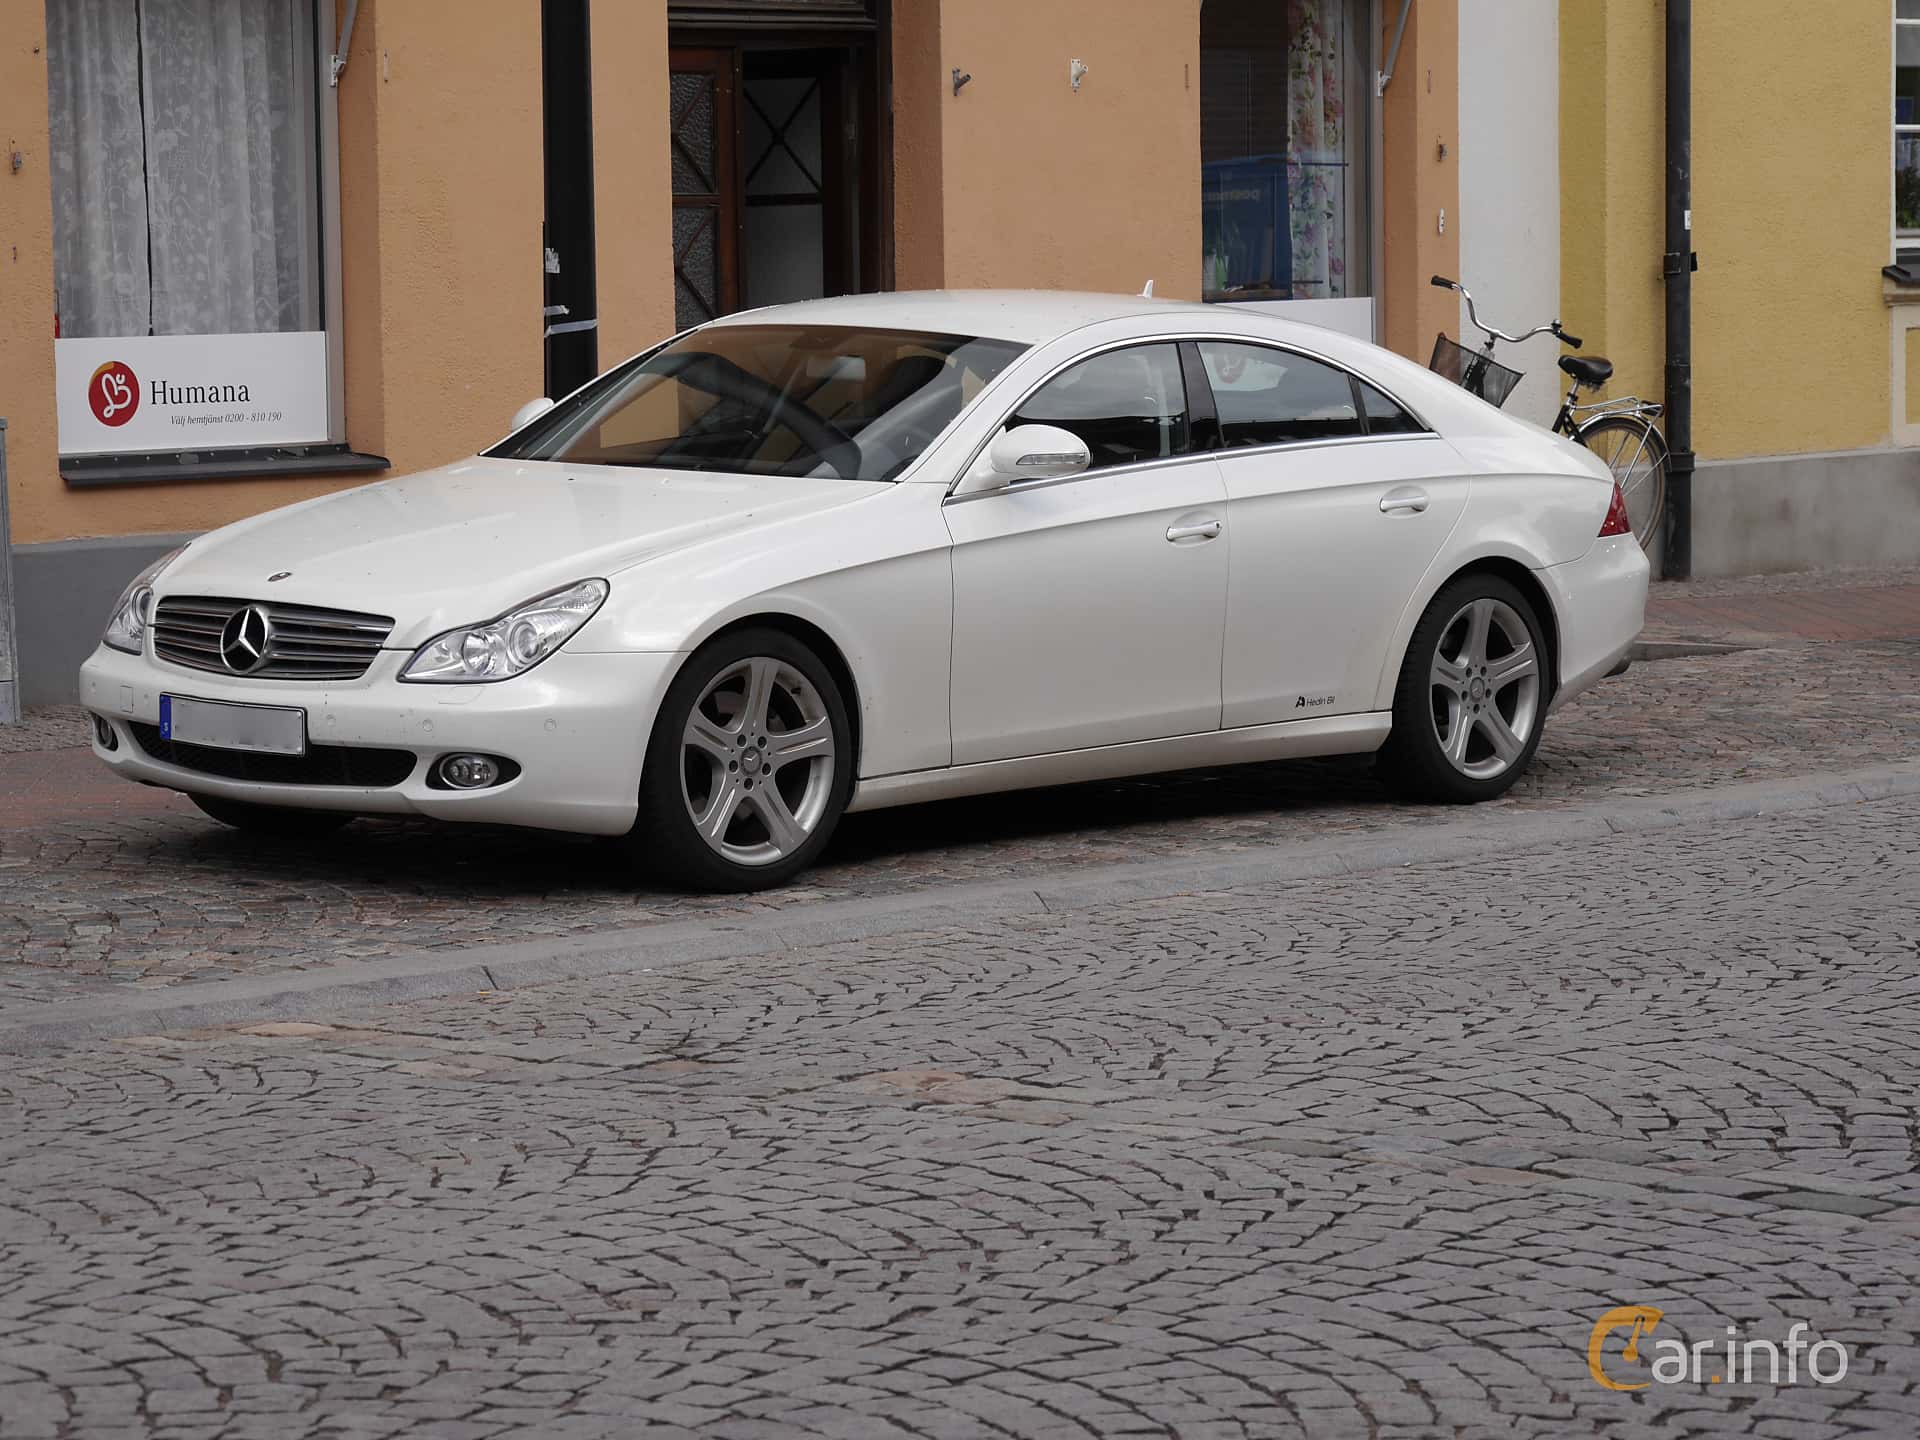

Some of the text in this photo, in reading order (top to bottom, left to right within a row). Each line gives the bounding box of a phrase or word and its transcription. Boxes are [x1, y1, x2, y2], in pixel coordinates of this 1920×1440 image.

[151, 380, 251, 405] Humana
[170, 415, 186, 427] Välj
[187, 414, 223, 426] hemtjänst
[225, 412, 245, 423] 0200
[251, 411, 265, 422] 810
[267, 411, 282, 422] 190
